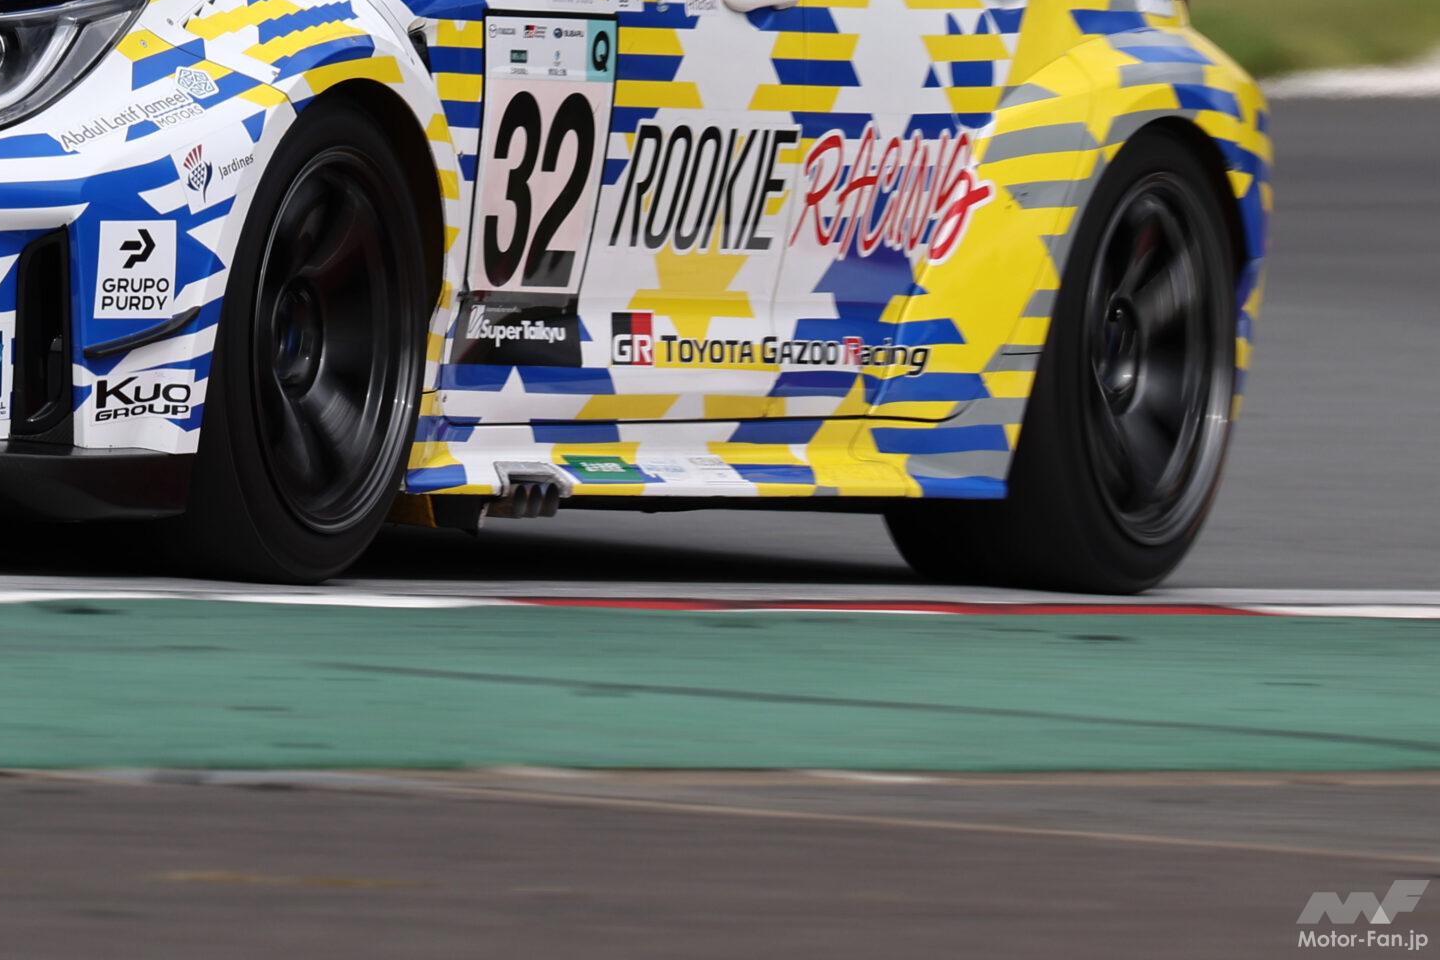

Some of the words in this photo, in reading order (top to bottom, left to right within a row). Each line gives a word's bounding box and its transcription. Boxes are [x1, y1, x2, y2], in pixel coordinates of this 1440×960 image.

[592, 30, 611, 72] Q
[60, 116, 106, 150] Abdul
[104, 106, 140, 131] Latif
[137, 89, 190, 119] Jameel
[155, 105, 204, 128] MOTORS
[218, 152, 255, 180] Jardines
[483, 90, 596, 287] 32
[610, 123, 799, 250] ROOKIE
[789, 126, 991, 261] RACING
[102, 278, 170, 293] GRUPO
[101, 296, 168, 311] PURDY
[612, 334, 654, 364] GR
[660, 334, 755, 364] TOYOTA
[761, 336, 839, 365] GAZOO
[843, 336, 930, 376] Racing
[95, 403, 190, 422] GROUP
